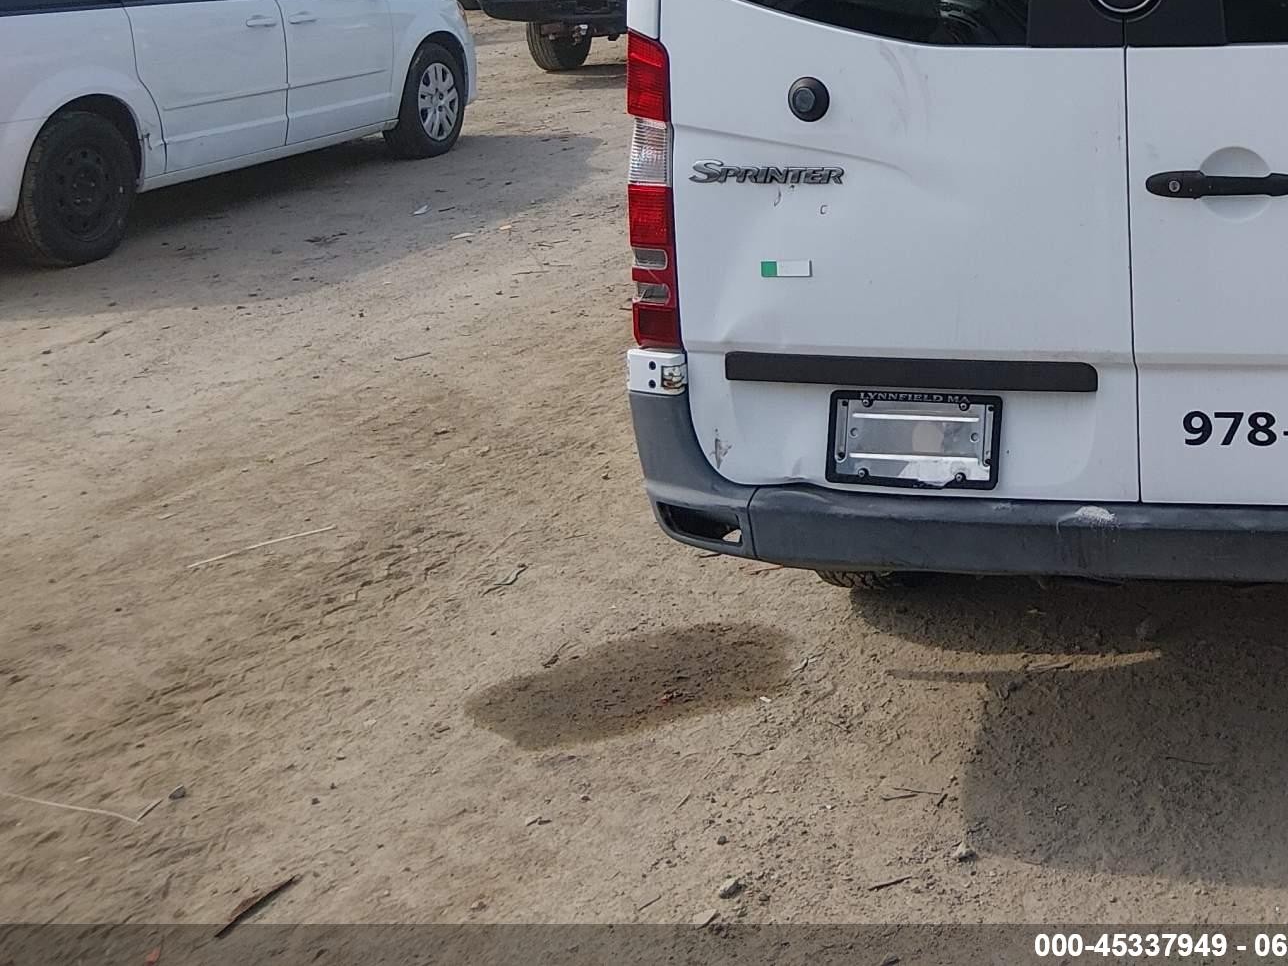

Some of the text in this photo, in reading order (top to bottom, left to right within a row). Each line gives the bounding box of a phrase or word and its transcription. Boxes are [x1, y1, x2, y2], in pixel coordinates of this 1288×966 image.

[688, 159, 846, 185] SPRINTER
[859, 392, 971, 404] LYNNFIELD MA
